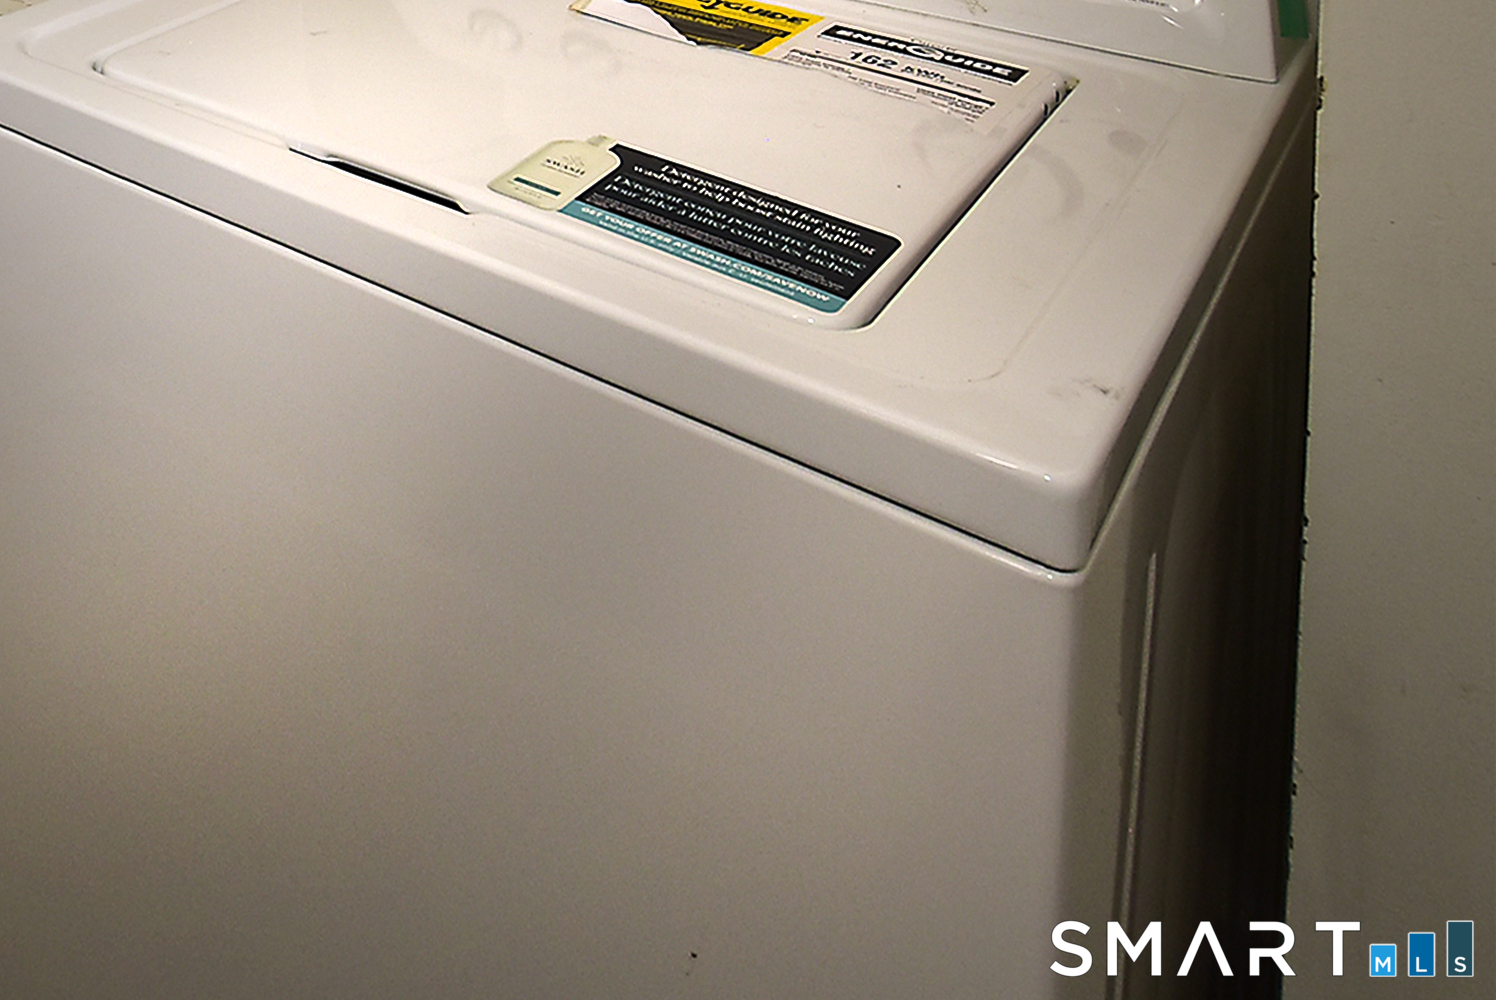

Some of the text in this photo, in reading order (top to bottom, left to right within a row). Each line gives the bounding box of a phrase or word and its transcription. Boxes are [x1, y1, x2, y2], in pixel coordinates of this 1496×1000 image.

[849, 50, 899, 70] 162
[660, 164, 731, 193] Detergent
[579, 207, 603, 218] GET
[603, 215, 635, 230] YOUR
[633, 227, 672, 243] OFFER
